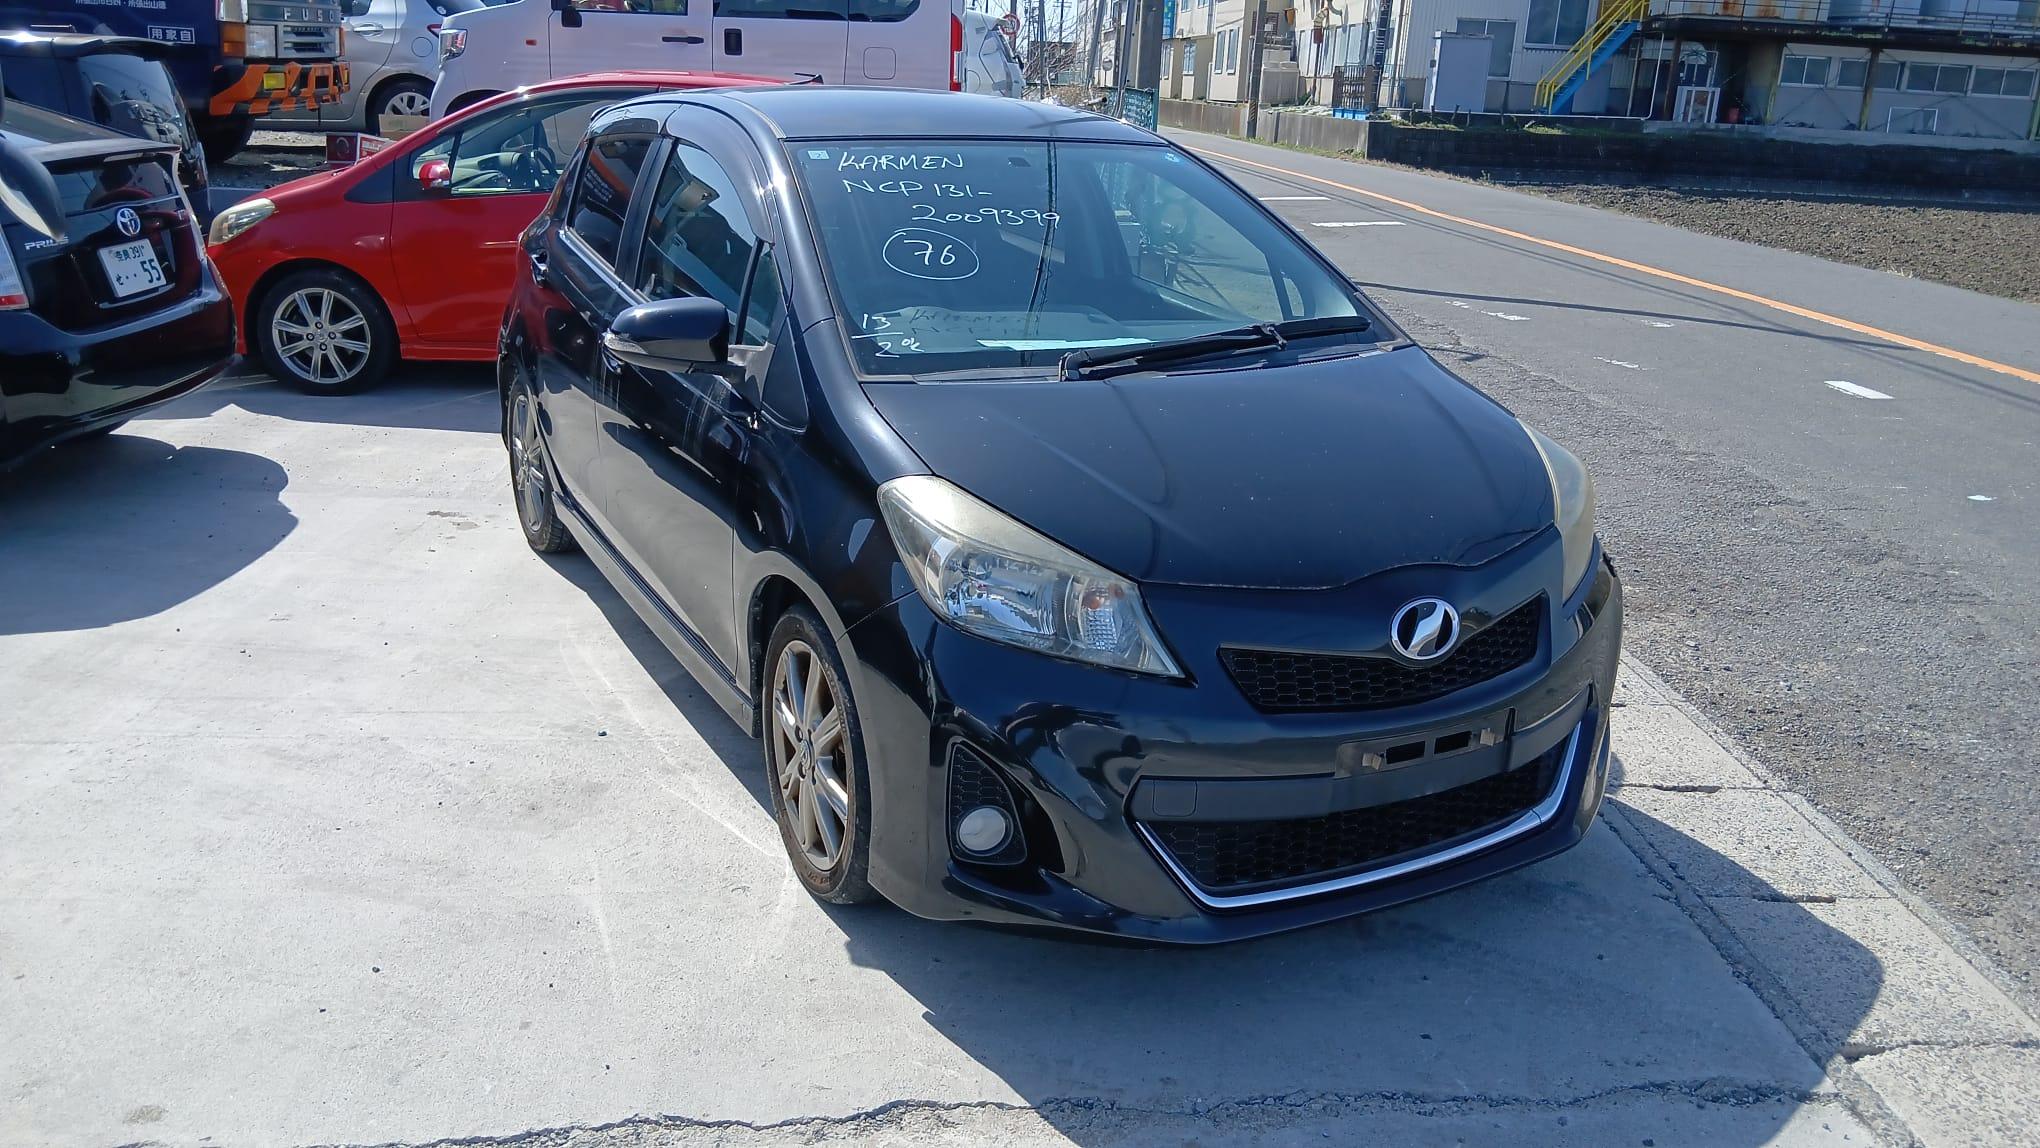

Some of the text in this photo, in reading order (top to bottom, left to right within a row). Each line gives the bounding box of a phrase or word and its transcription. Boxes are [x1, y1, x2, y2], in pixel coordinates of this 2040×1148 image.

[837, 151, 964, 172] KARMEN
[911, 204, 1062, 229] 2009399
[904, 239, 956, 266] 76
